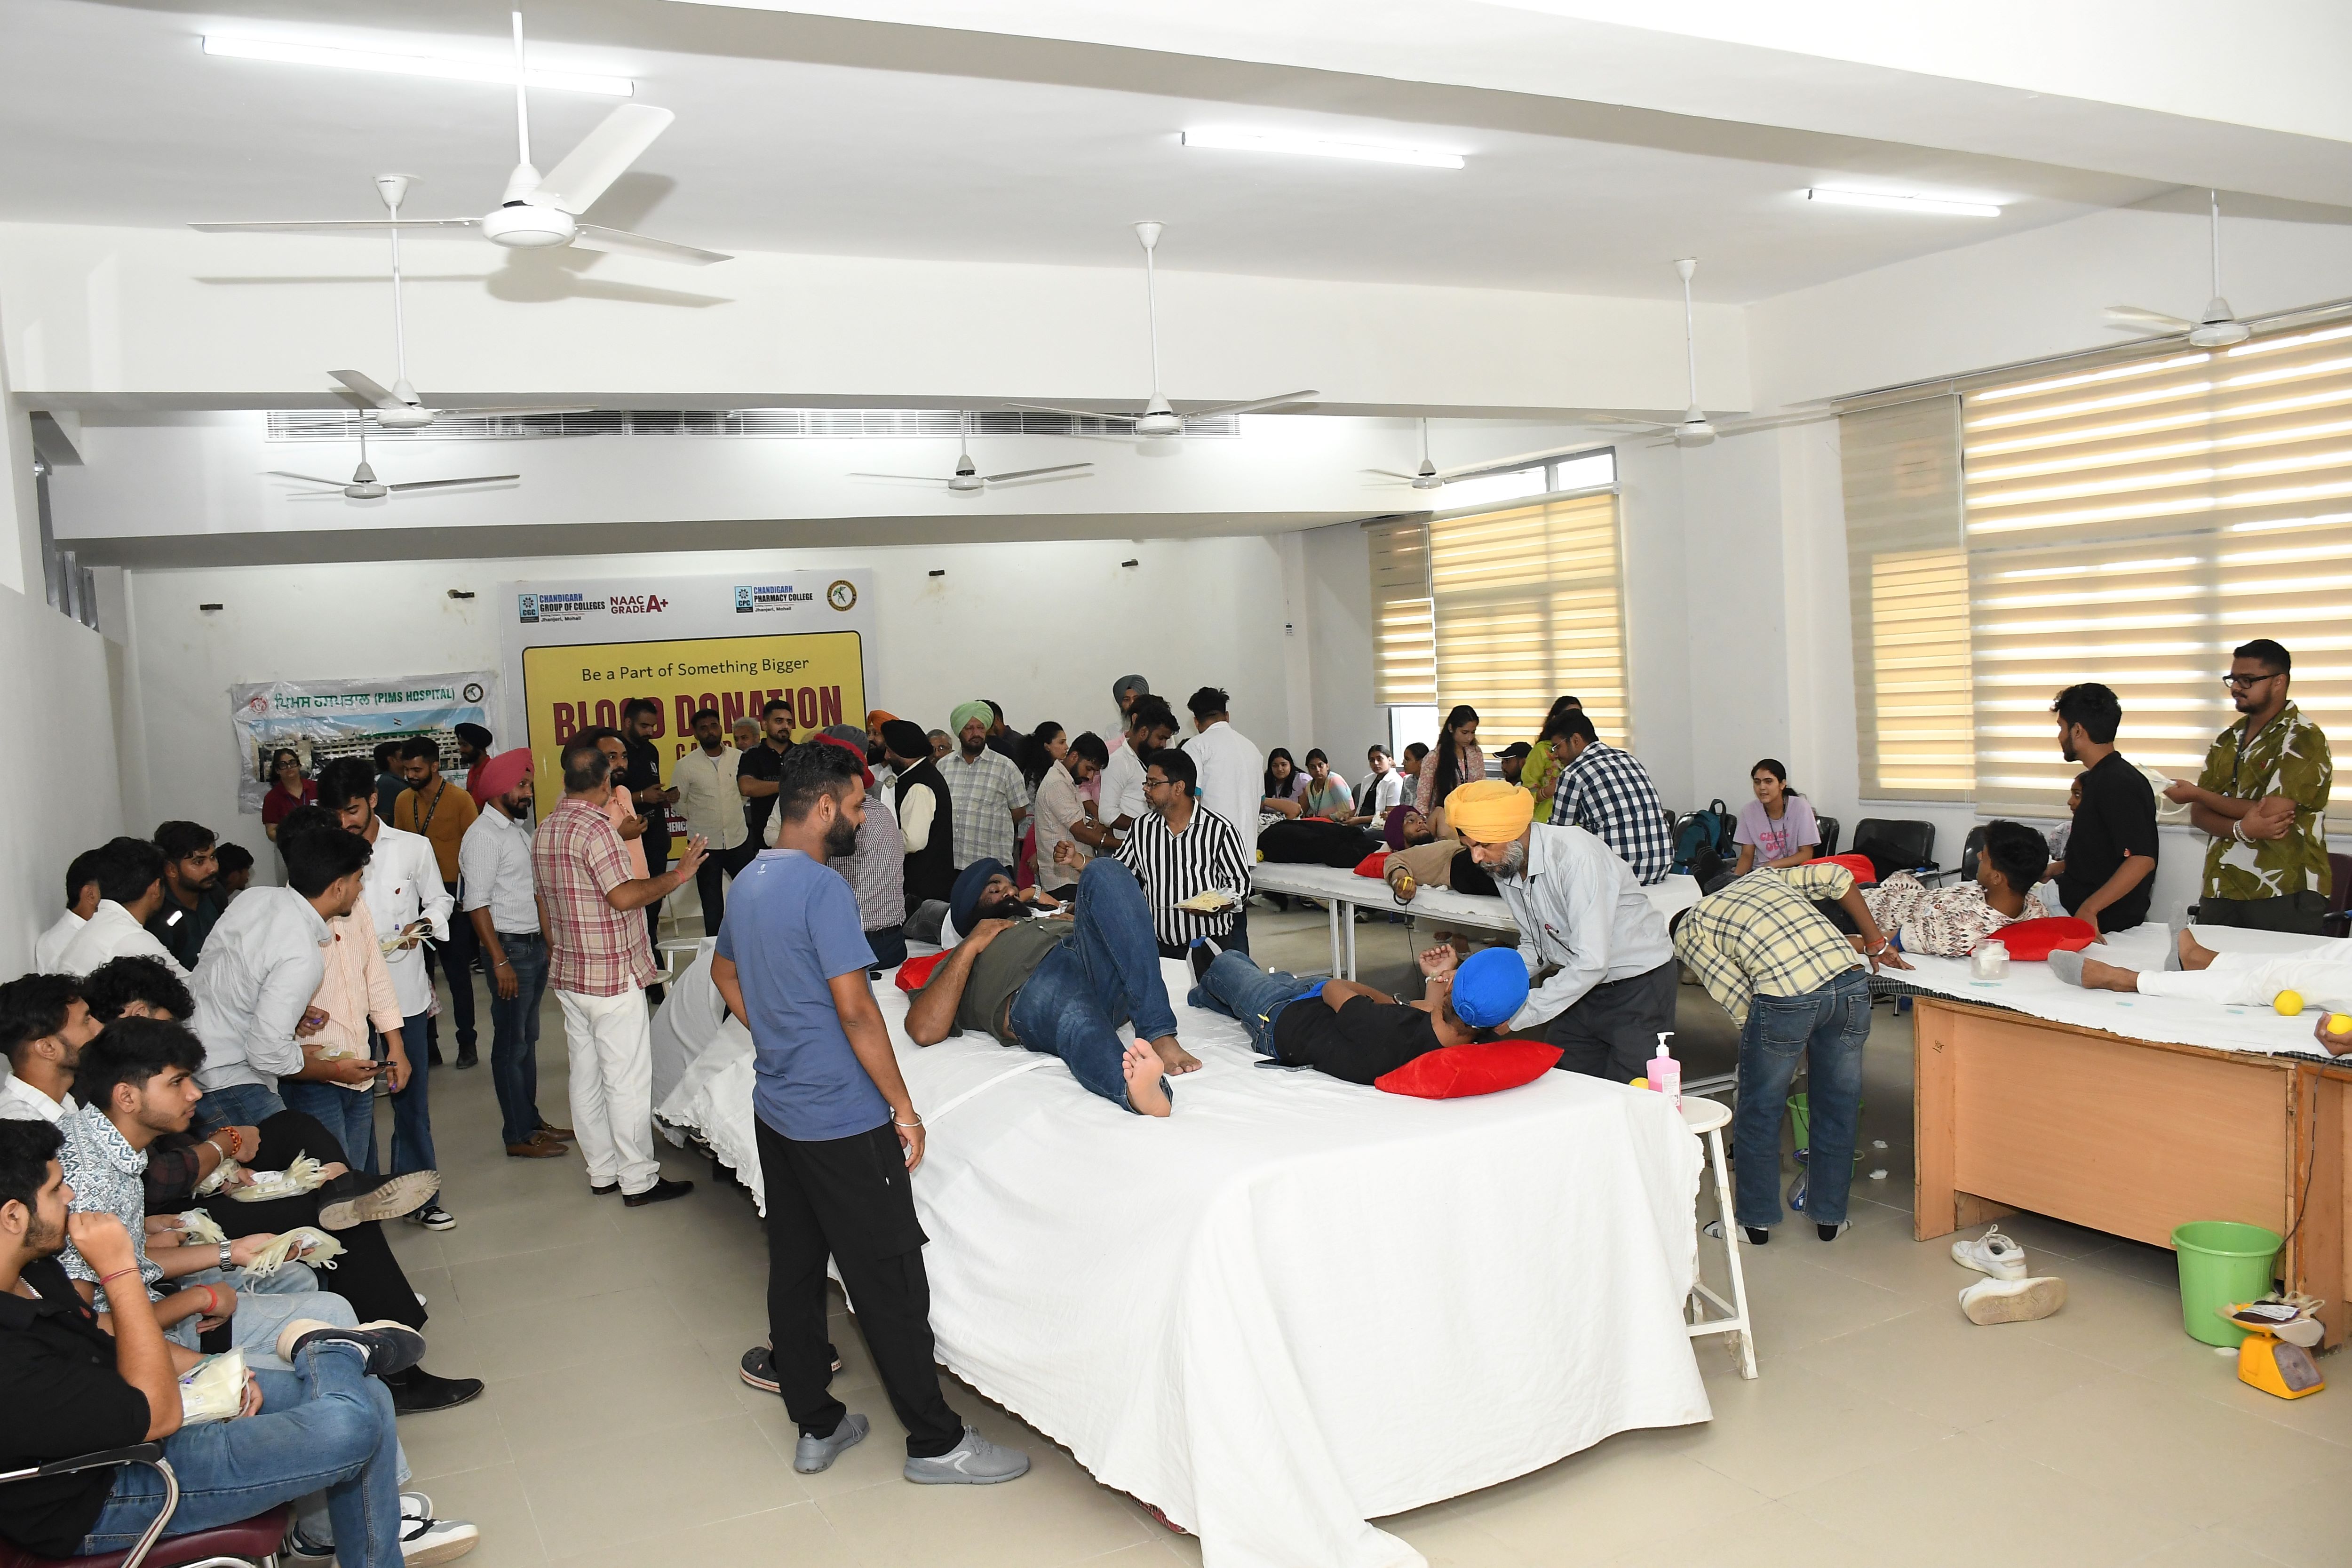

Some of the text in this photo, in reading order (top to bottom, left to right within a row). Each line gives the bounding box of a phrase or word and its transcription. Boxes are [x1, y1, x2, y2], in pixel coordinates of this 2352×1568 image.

[754, 585, 793, 594] CHANDIGARH
[540, 593, 583, 603] CHANDIGARH
[610, 596, 644, 605] NAAC
[754, 593, 813, 603] PHARMACY COLLEGE
[540, 601, 605, 612] GROUP OF COLLEGES
[646, 595, 668, 613] A+
[611, 605, 645, 614] GRADE
[582, 658, 809, 681] Be a Part of Something Bigger
[375, 691, 402, 706] (PIMS
[406, 688, 455, 701] HOSPITAL)
